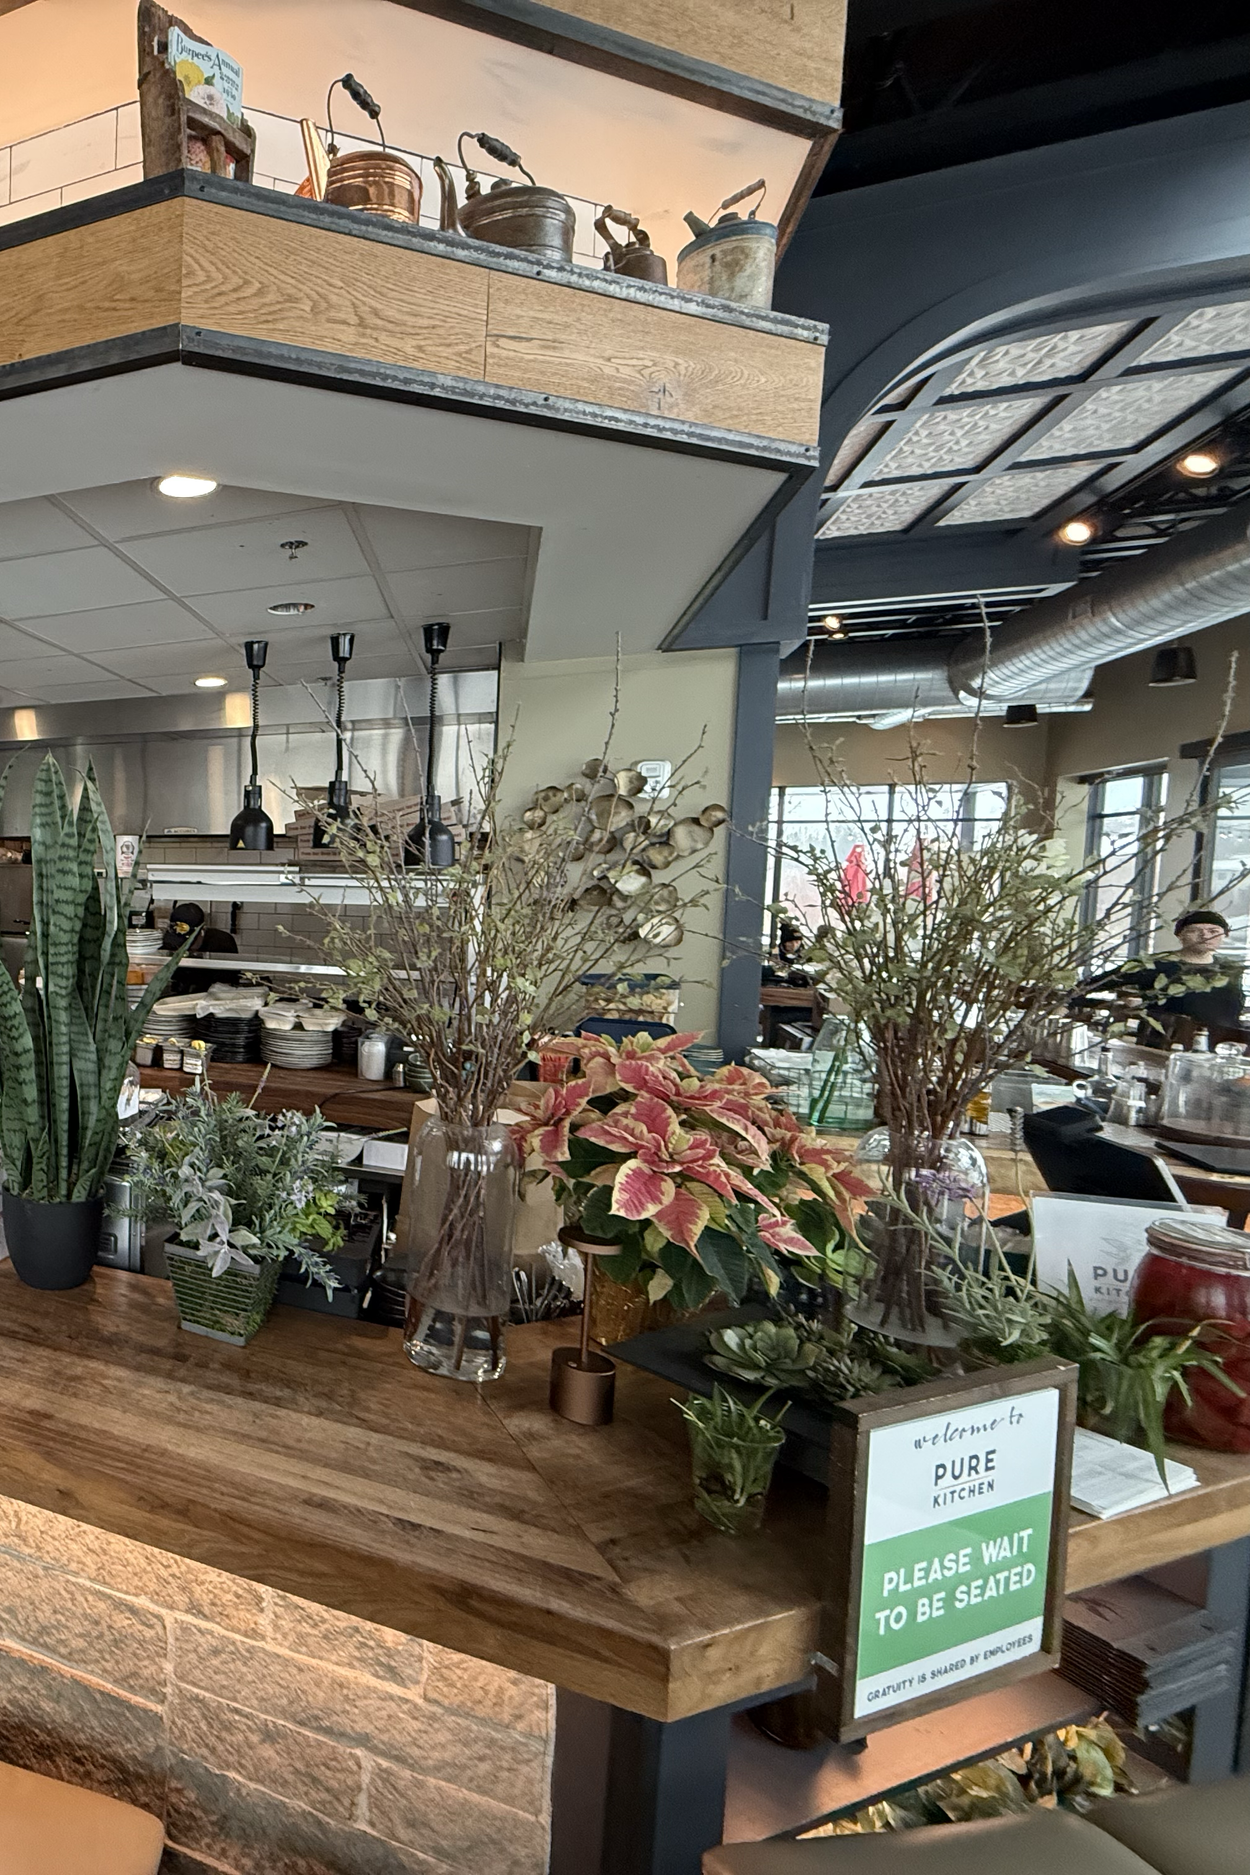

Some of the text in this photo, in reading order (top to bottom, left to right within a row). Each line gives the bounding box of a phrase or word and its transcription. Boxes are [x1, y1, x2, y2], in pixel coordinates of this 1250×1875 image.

[210, 52, 240, 78] Annual
[1092, 1266, 1129, 1283] PU
[914, 1406, 1024, 1449] welcome to
[934, 1449, 997, 1487] PURE
[933, 1479, 995, 1508] KITCHEN
[882, 1528, 1034, 1597] PLEASE WAIT
[875, 1562, 1036, 1636] TO BE SEATED
[867, 1633, 1033, 1702] GRATUITY IS SHARED BY EMPLOYEES
